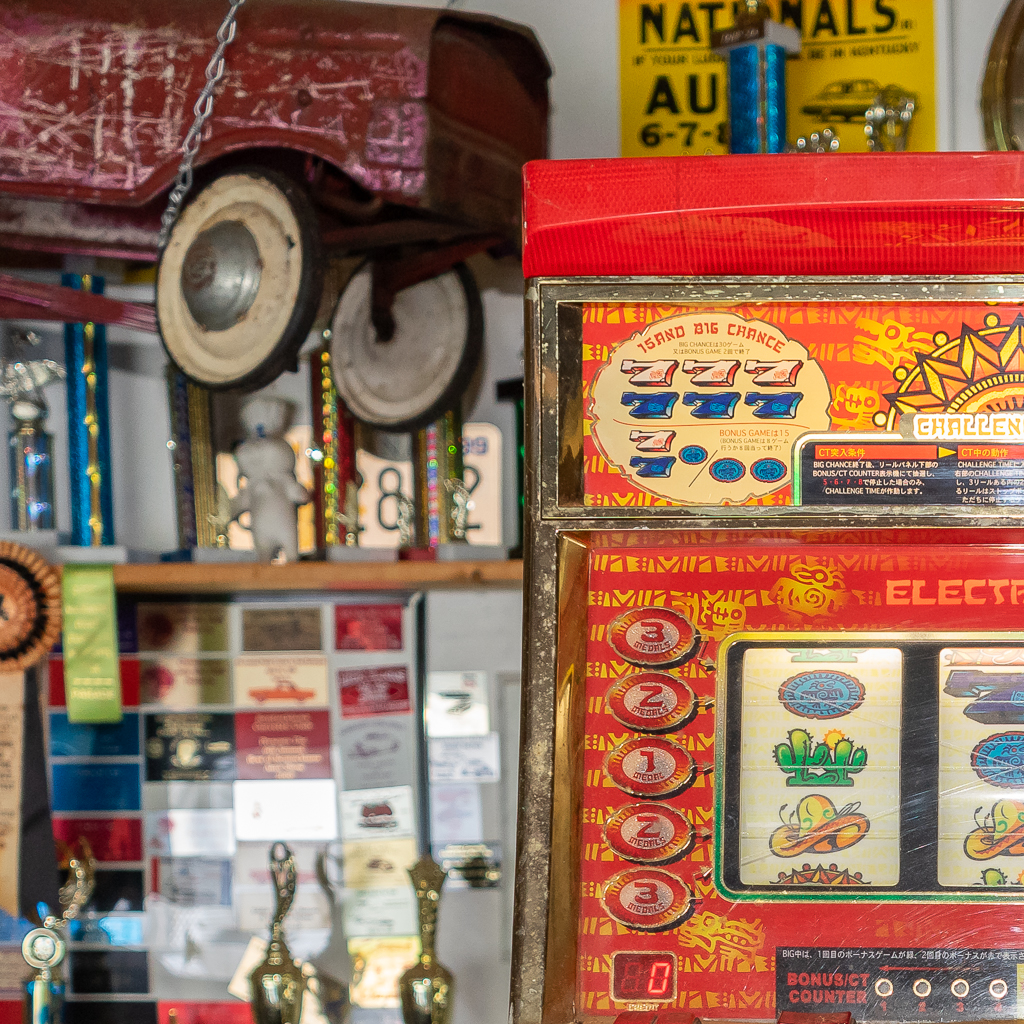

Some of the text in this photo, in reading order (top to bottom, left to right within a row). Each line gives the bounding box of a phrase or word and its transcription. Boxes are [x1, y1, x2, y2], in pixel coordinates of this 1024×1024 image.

[640, 0, 896, 42] NATNALS
[647, 73, 719, 115] AU
[636, 322, 786, 353] 15AND BIG CHANCE
[818, 448, 866, 457] CT突入条件
[962, 448, 1008, 457] CT中の動作
[640, 622, 664, 642] 3
[633, 640, 672, 651] MEDALS
[639, 686, 663, 707] 2
[631, 706, 668, 717] MEDALS
[640, 751, 656, 772] 1
[632, 772, 665, 782] MEDAL
[636, 816, 660, 838] 2
[628, 836, 666, 848] MEDALS
[634, 882, 660, 904] 3
[626, 902, 664, 914] MEDALS
[648, 962, 671, 995] 0
[786, 972, 870, 986] BONUS/CT
[788, 990, 868, 1004] COUNTER
[880, 1002, 888, 1012] 1
[918, 1002, 926, 1012] 2
[956, 1002, 964, 1012] 3
